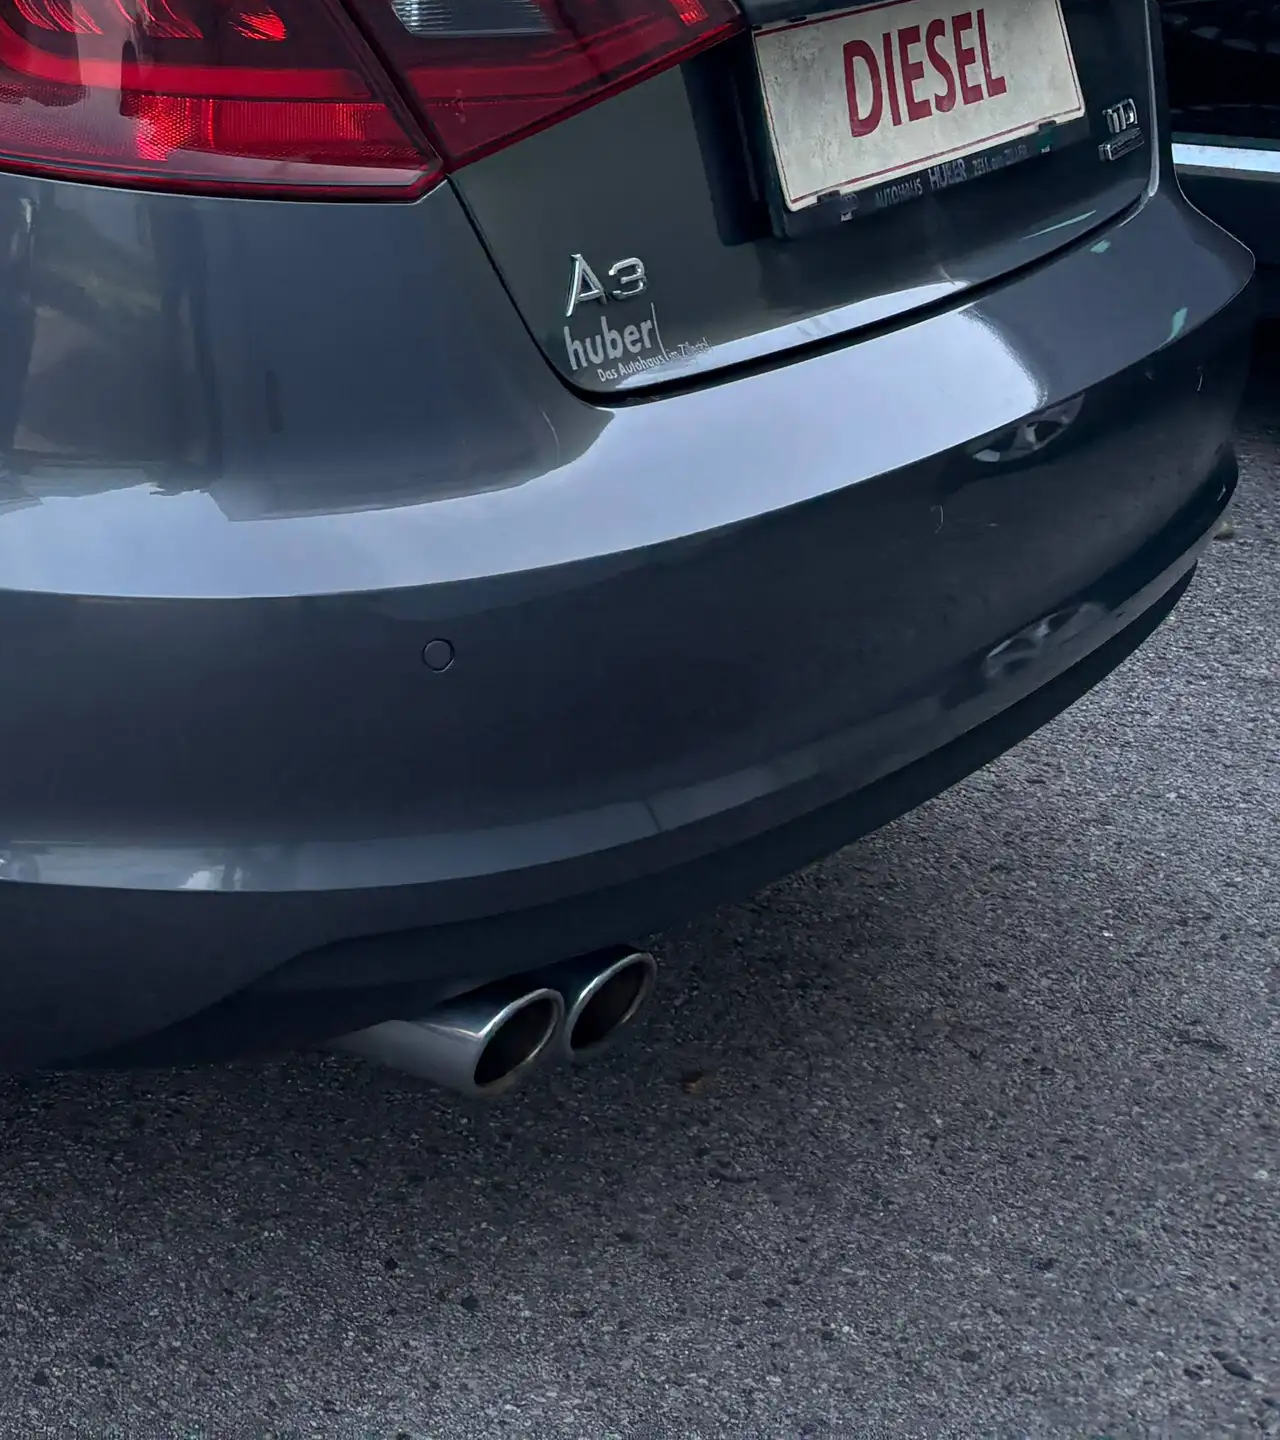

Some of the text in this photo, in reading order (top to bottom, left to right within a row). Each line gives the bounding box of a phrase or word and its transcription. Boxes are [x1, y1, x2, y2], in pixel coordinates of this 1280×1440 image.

[842, 7, 1007, 137] DIESEL
[565, 253, 647, 317] A3
[563, 315, 653, 371] huber
[597, 368, 618, 382] Das
[618, 355, 665, 376] Autohaus
